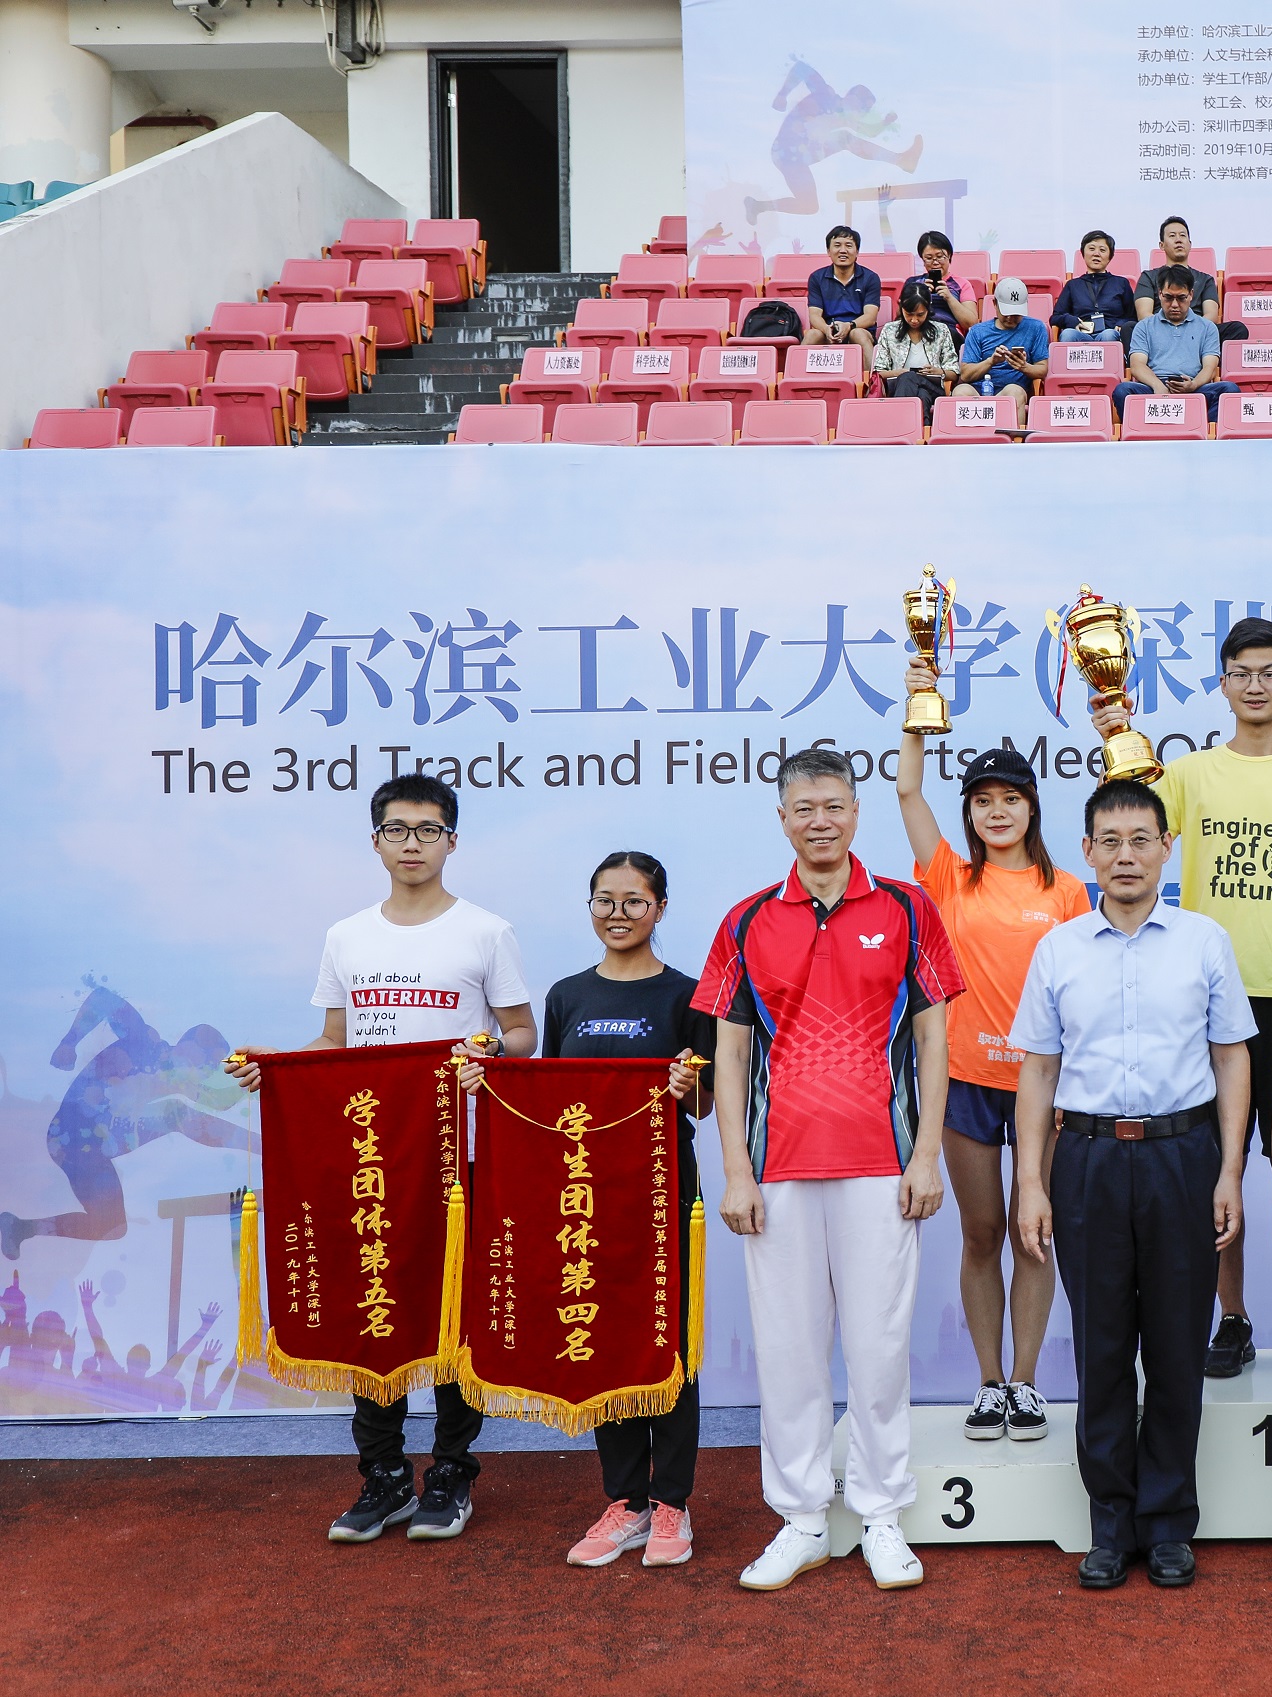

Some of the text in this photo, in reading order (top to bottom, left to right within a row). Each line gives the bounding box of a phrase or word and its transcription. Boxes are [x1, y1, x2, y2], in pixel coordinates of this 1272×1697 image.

[545, 356, 580, 369] 人力资源处
[635, 354, 670, 368] 科学技术处
[808, 352, 843, 367] 学校办公室
[957, 405, 995, 420] 梁大鹏
[1053, 405, 1089, 420] 韩喜双
[1146, 402, 1184, 418] 姚英学
[152, 747, 251, 793] The
[272, 744, 357, 792] 3rd
[379, 741, 525, 789] Track
[543, 738, 640, 787] and
[666, 737, 786, 785] Field
[1001, 736, 1101, 780] Mee
[1230, 836, 1261, 859] of
[1215, 855, 1257, 877] the
[352, 972, 421, 986] It's all about
[354, 990, 456, 1008] MATERIALS
[372, 1012, 397, 1024] you
[355, 1024, 397, 1036] wuldn't
[592, 1021, 637, 1034] START
[343, 1088, 396, 1337] 学生团体第五名
[555, 1102, 599, 1362] 学生团体第四名
[301, 1201, 321, 1329] 哈尔滨工业大学(深圳)
[502, 1216, 517, 1350] 哈尔滨工业大学(深圳)
[940, 1476, 977, 1532] 3
